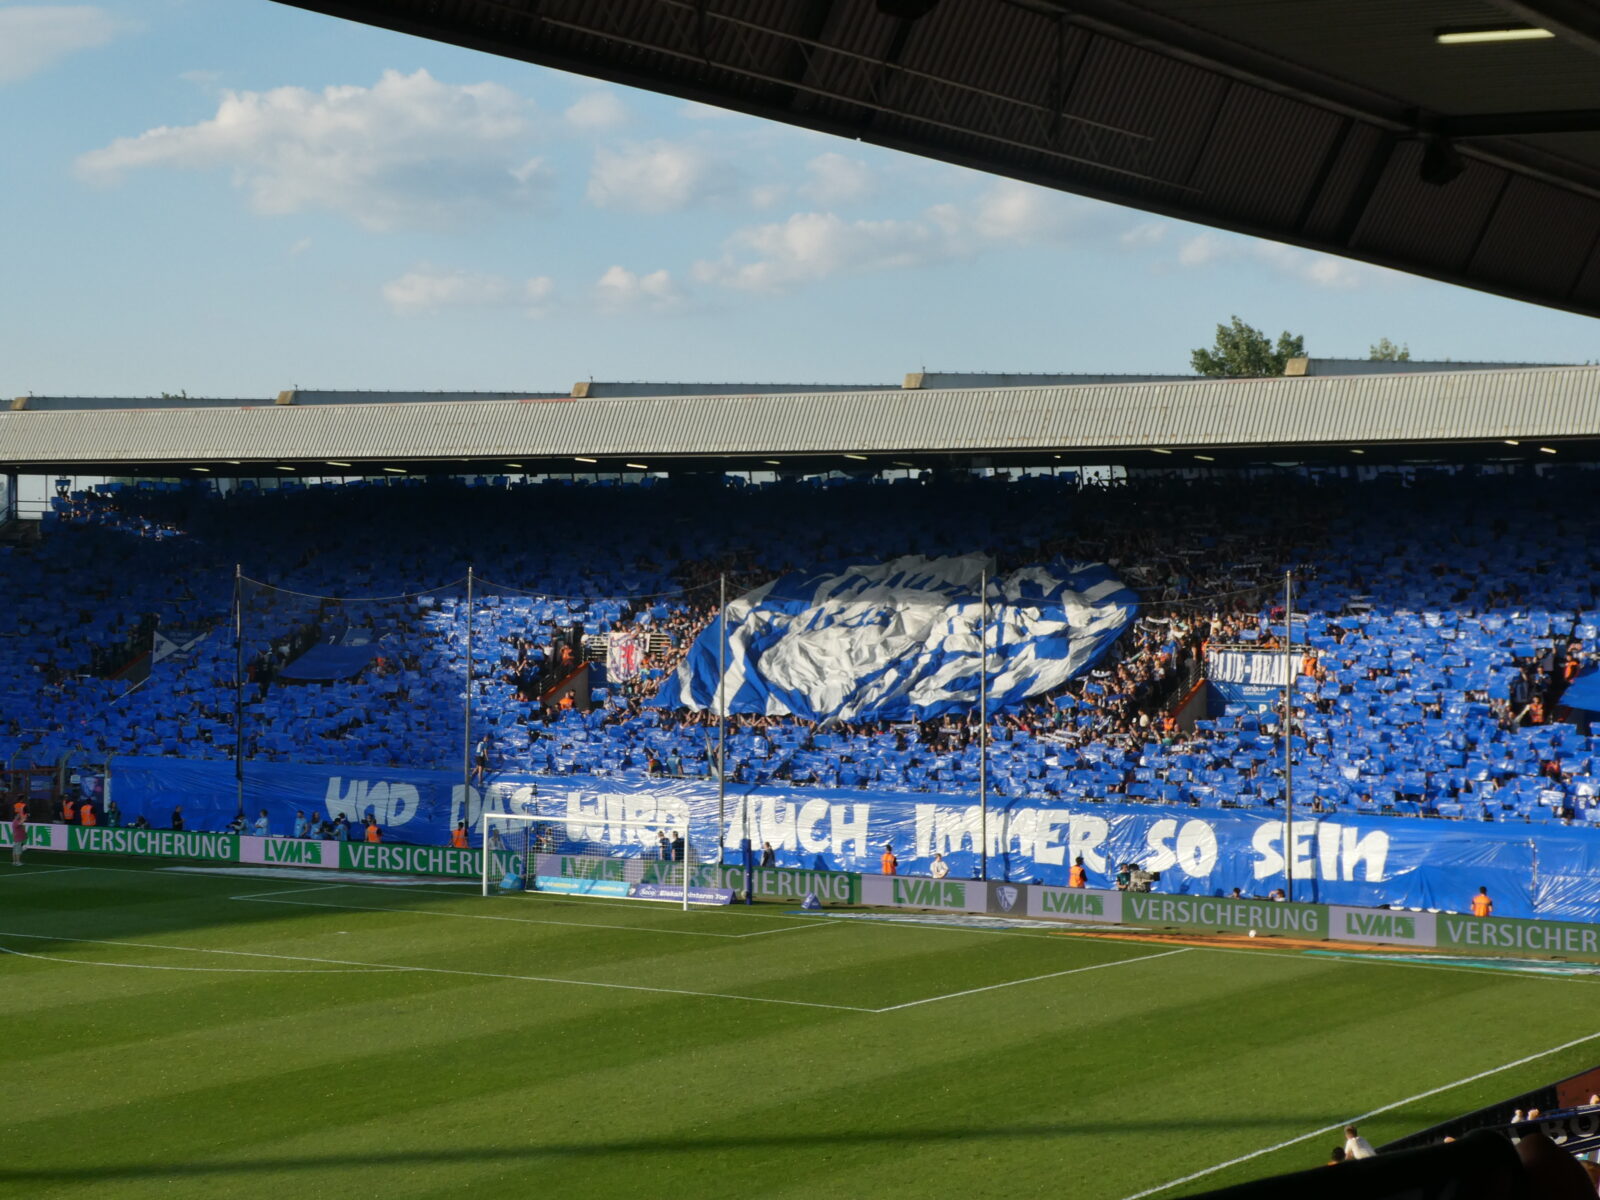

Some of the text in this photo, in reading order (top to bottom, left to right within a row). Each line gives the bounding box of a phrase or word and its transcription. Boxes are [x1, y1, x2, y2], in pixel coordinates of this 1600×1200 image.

[75, 828, 231, 859] VERSICHERUNG
[452, 783, 537, 834] DAS
[567, 792, 689, 848] WIRD
[725, 795, 870, 857] AUCH
[1146, 818, 1218, 878] SO
[347, 844, 523, 877] VERSICHERUNG
[653, 863, 850, 900] VERSICHERUNG
[1132, 898, 1318, 932] VERSICHERUNG
